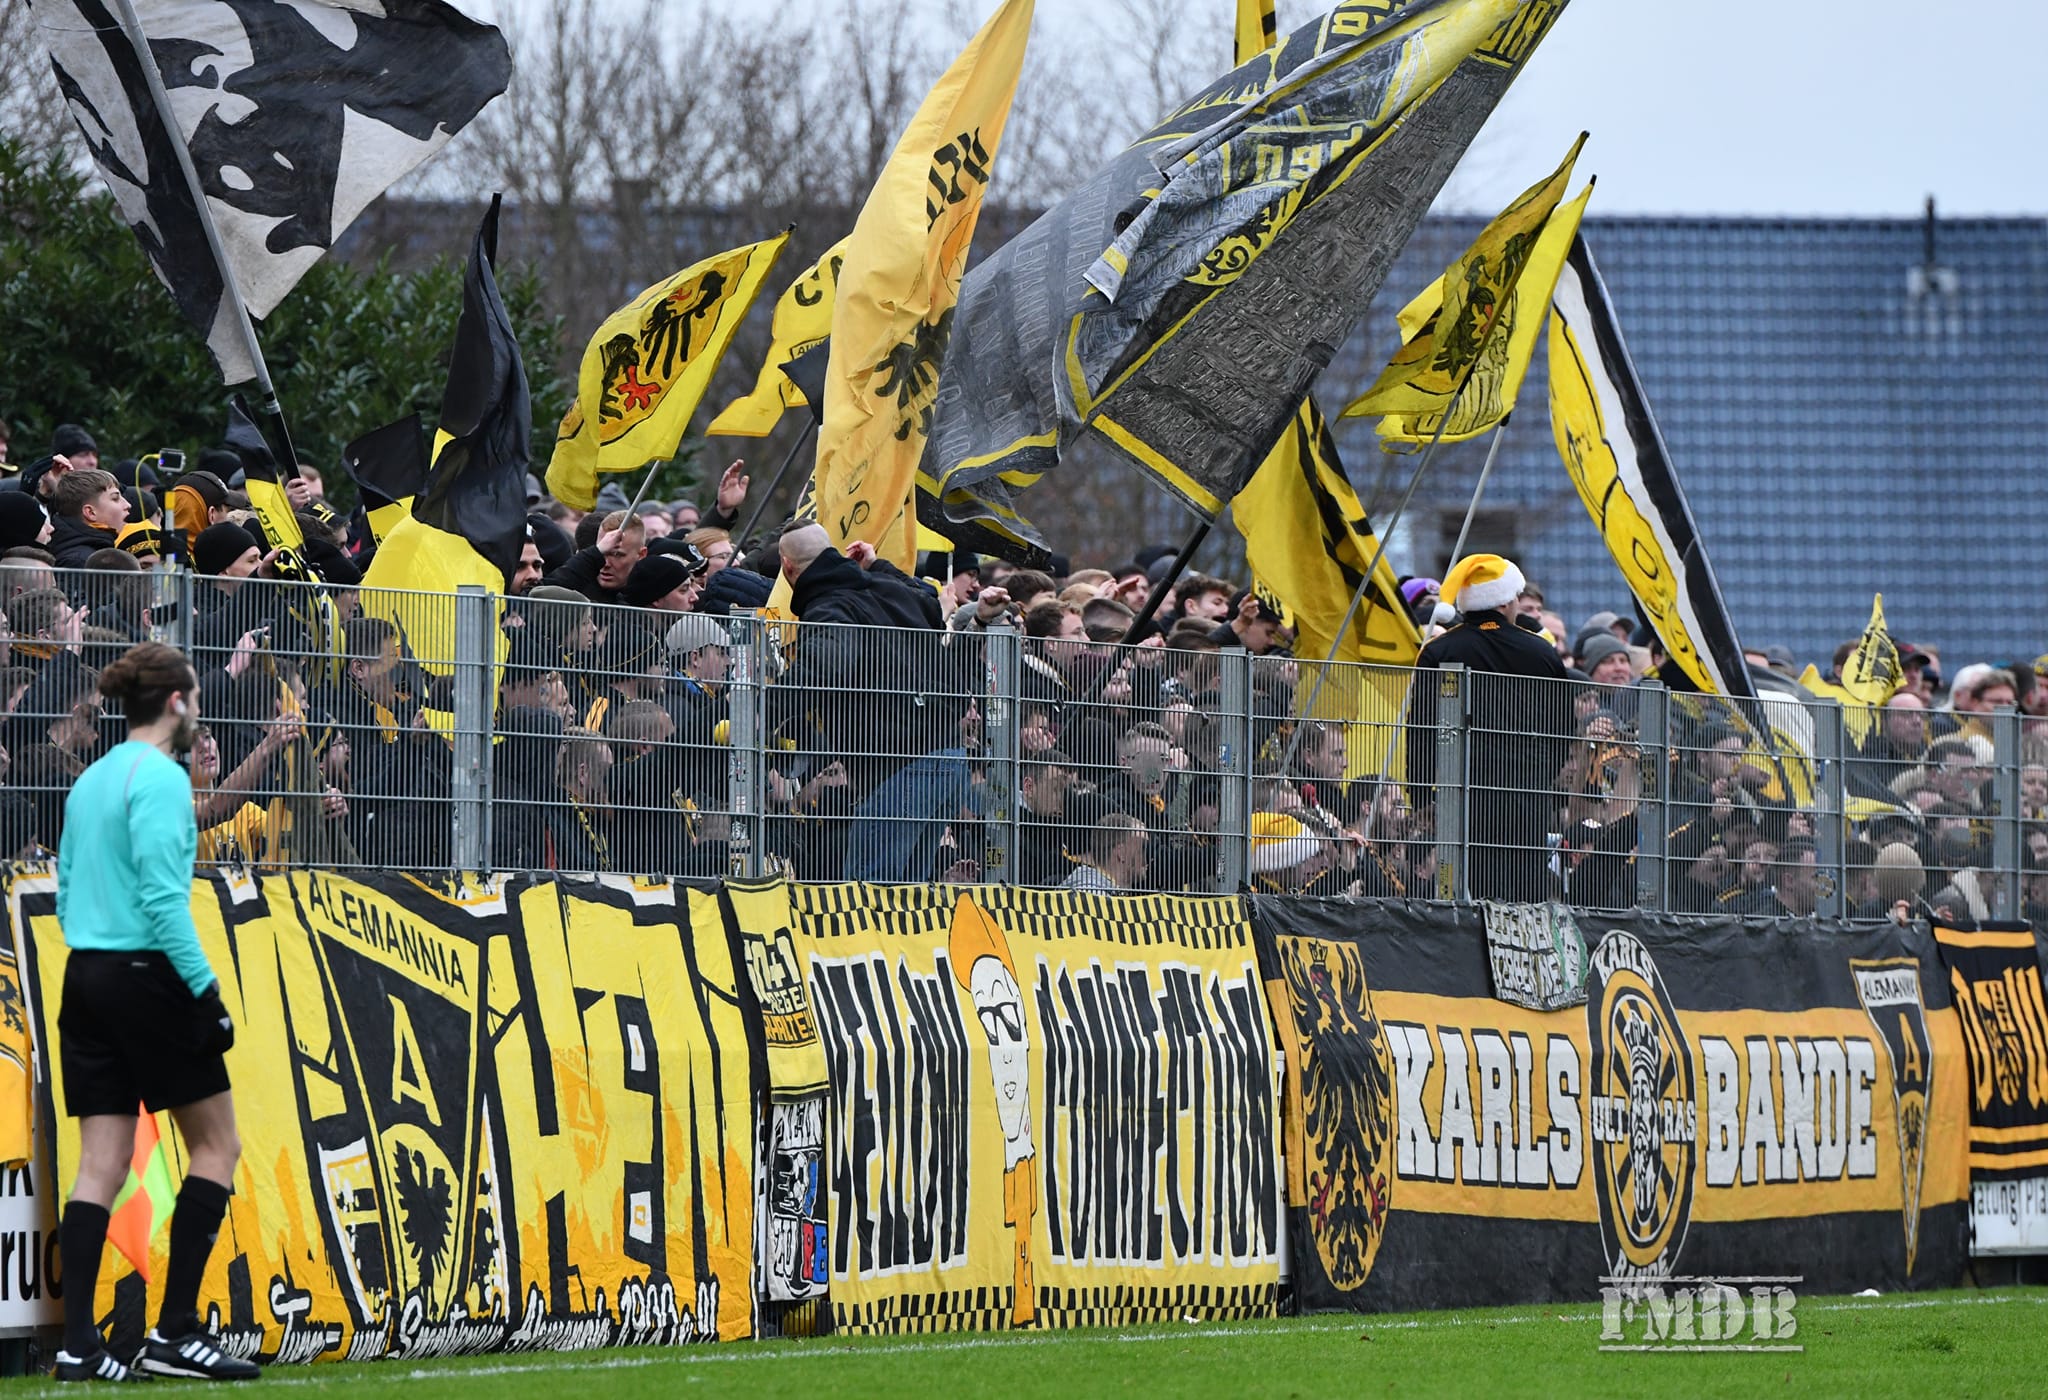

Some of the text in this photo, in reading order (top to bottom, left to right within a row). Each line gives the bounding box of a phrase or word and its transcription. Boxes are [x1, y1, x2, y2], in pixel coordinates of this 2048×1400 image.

[310, 881, 470, 997] ALEMANNIA
[1595, 933, 1655, 989] KARLS
[388, 994, 442, 1127] A
[1384, 1022, 1583, 1188] KARLS
[1700, 1035, 1877, 1187] BANDE
[1899, 1012, 1923, 1083] A
[809, 950, 1279, 1282] YELLOW CONNECTION
[1977, 1180, 2048, 1226] atung Pla
